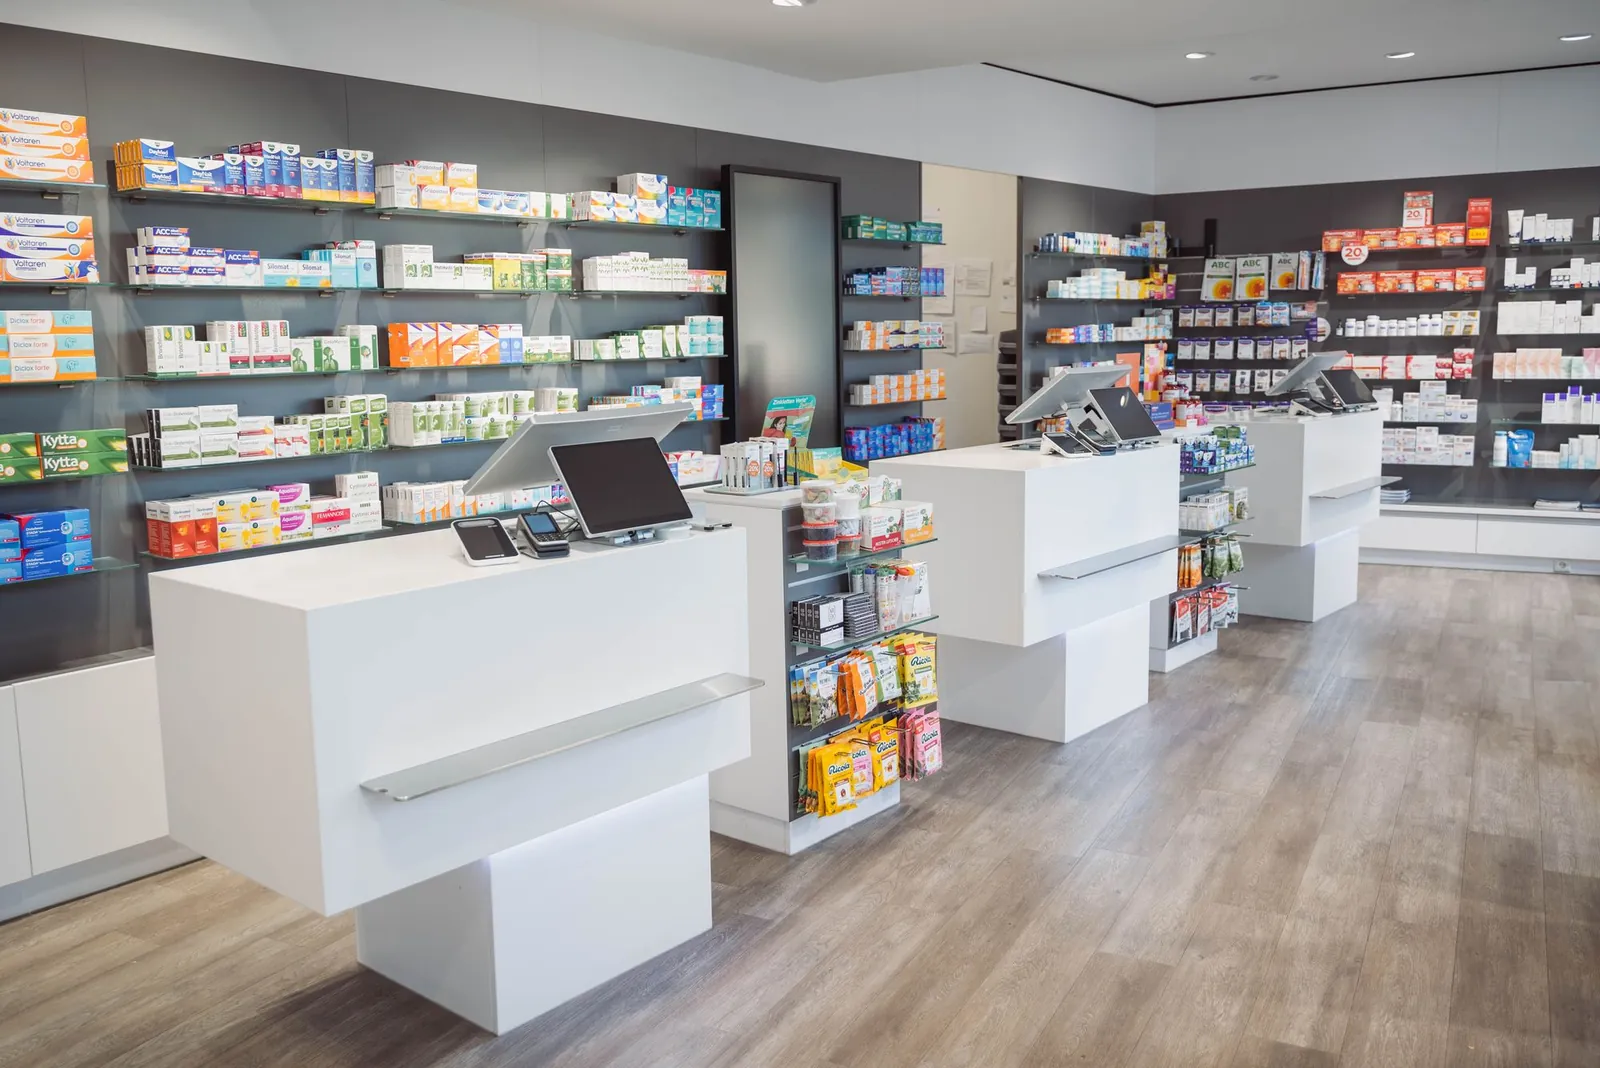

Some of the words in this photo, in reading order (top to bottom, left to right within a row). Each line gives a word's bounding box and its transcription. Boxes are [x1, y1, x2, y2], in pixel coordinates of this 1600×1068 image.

[11, 113, 40, 122] Voltaren
[11, 136, 40, 144] Voltaren
[16, 159, 45, 167] Voltaren
[14, 260, 46, 268] Voltaren
[42, 435, 77, 449] Kytta
[44, 457, 79, 471] Kytta
[910, 656, 931, 666] Ricola
[921, 730, 938, 744] Ricola
[877, 738, 897, 753] Ricola
[852, 750, 867, 759] cola
[828, 763, 850, 775] Ricola
